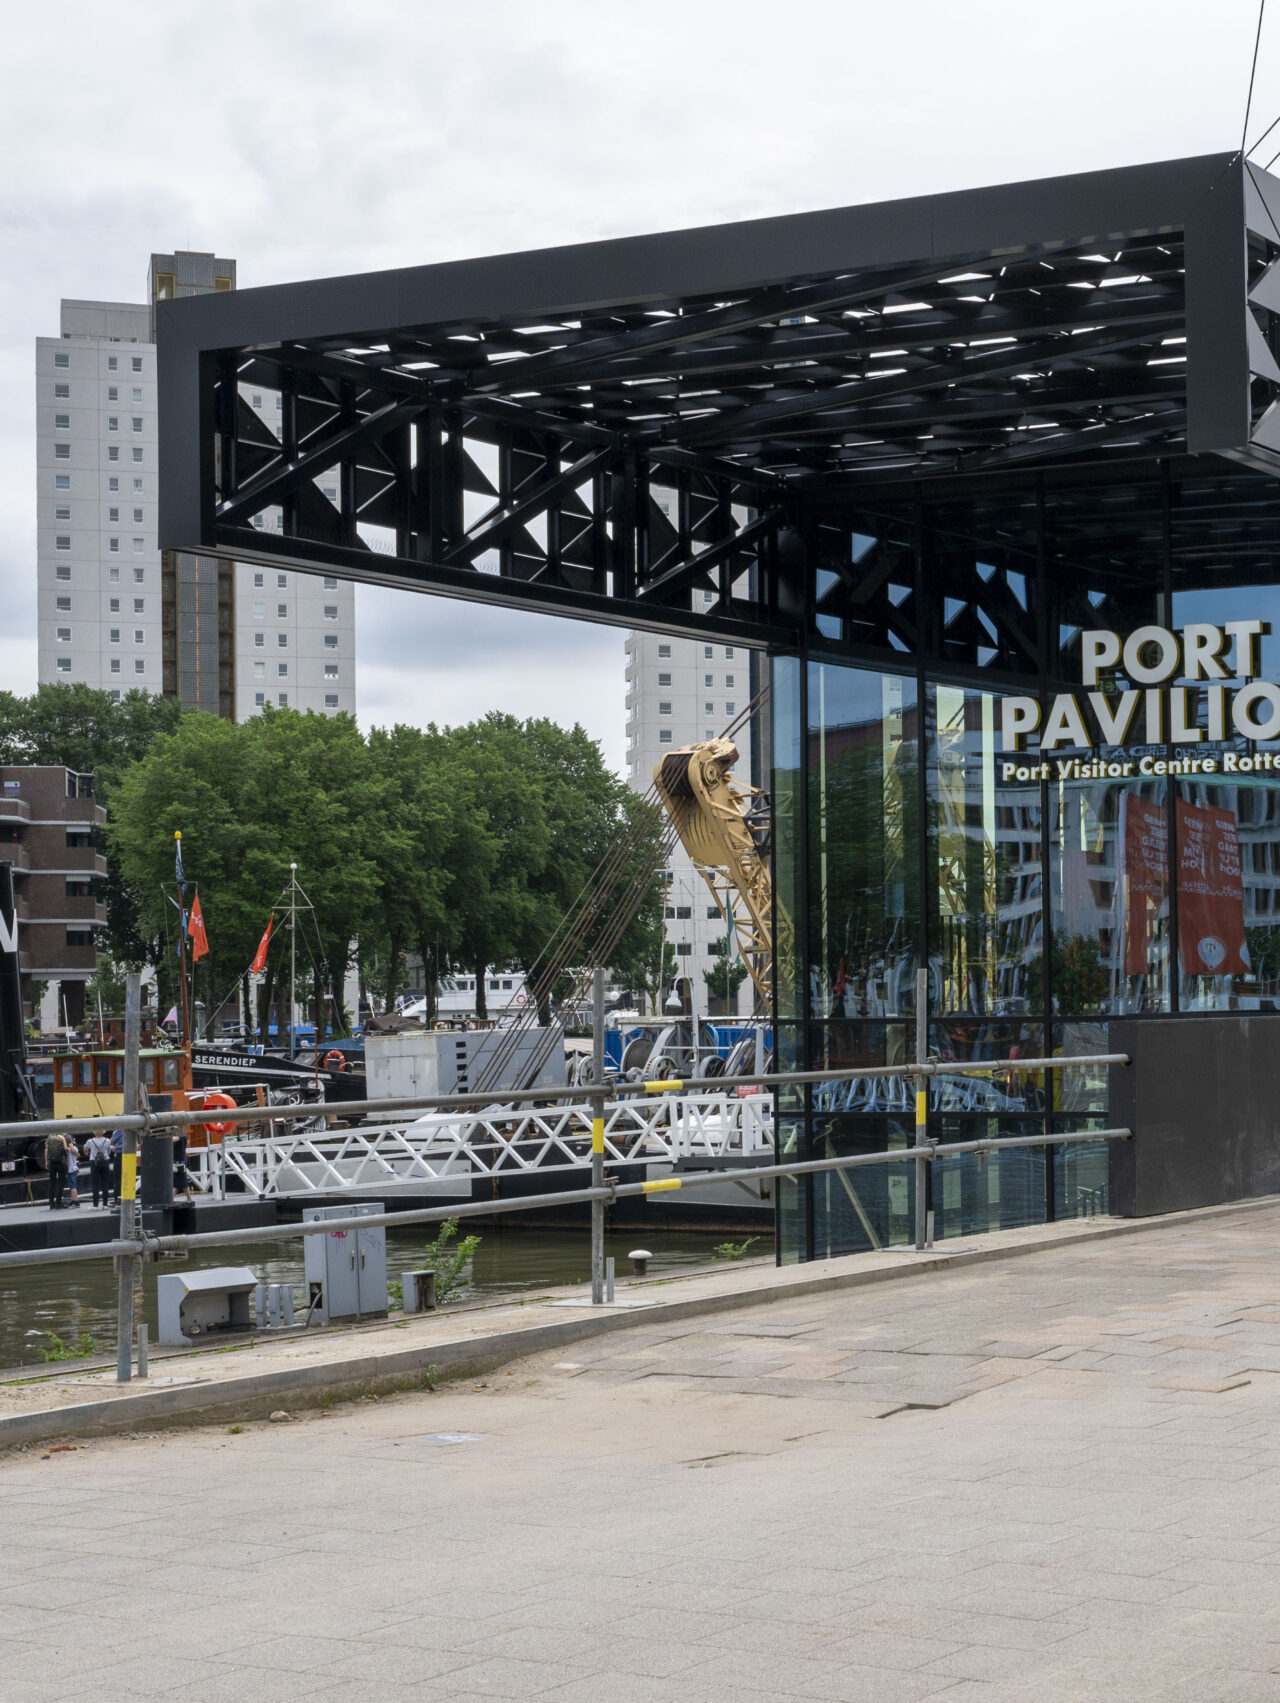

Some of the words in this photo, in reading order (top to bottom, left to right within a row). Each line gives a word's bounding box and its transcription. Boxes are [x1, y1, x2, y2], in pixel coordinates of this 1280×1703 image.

[1082, 620, 1263, 685] PORT
[1002, 762, 1050, 781] Port
[1057, 758, 1135, 780] Visitor
[1139, 755, 1218, 776] Centre
[195, 1054, 257, 1067] SERENDIEP
